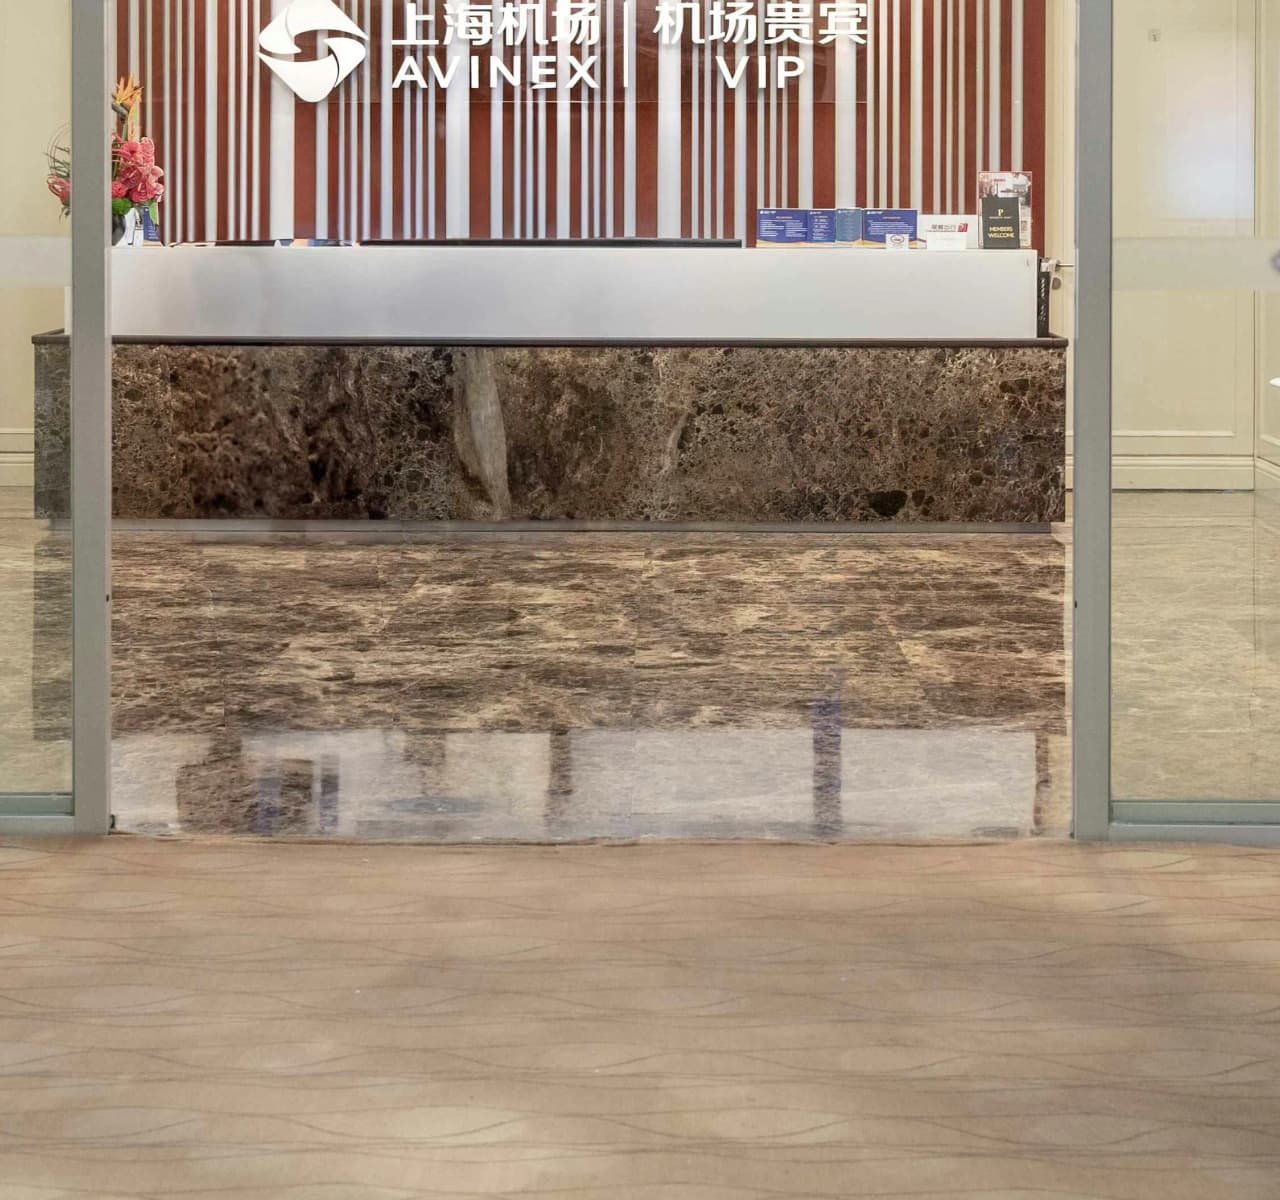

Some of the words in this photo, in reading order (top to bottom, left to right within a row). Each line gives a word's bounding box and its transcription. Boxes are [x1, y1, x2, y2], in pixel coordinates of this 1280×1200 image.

[392, 2, 600, 46] 上海机场
[654, 1, 869, 46] 机场贵宾
[392, 55, 599, 89] AVINEX
[715, 55, 806, 89] VIP
